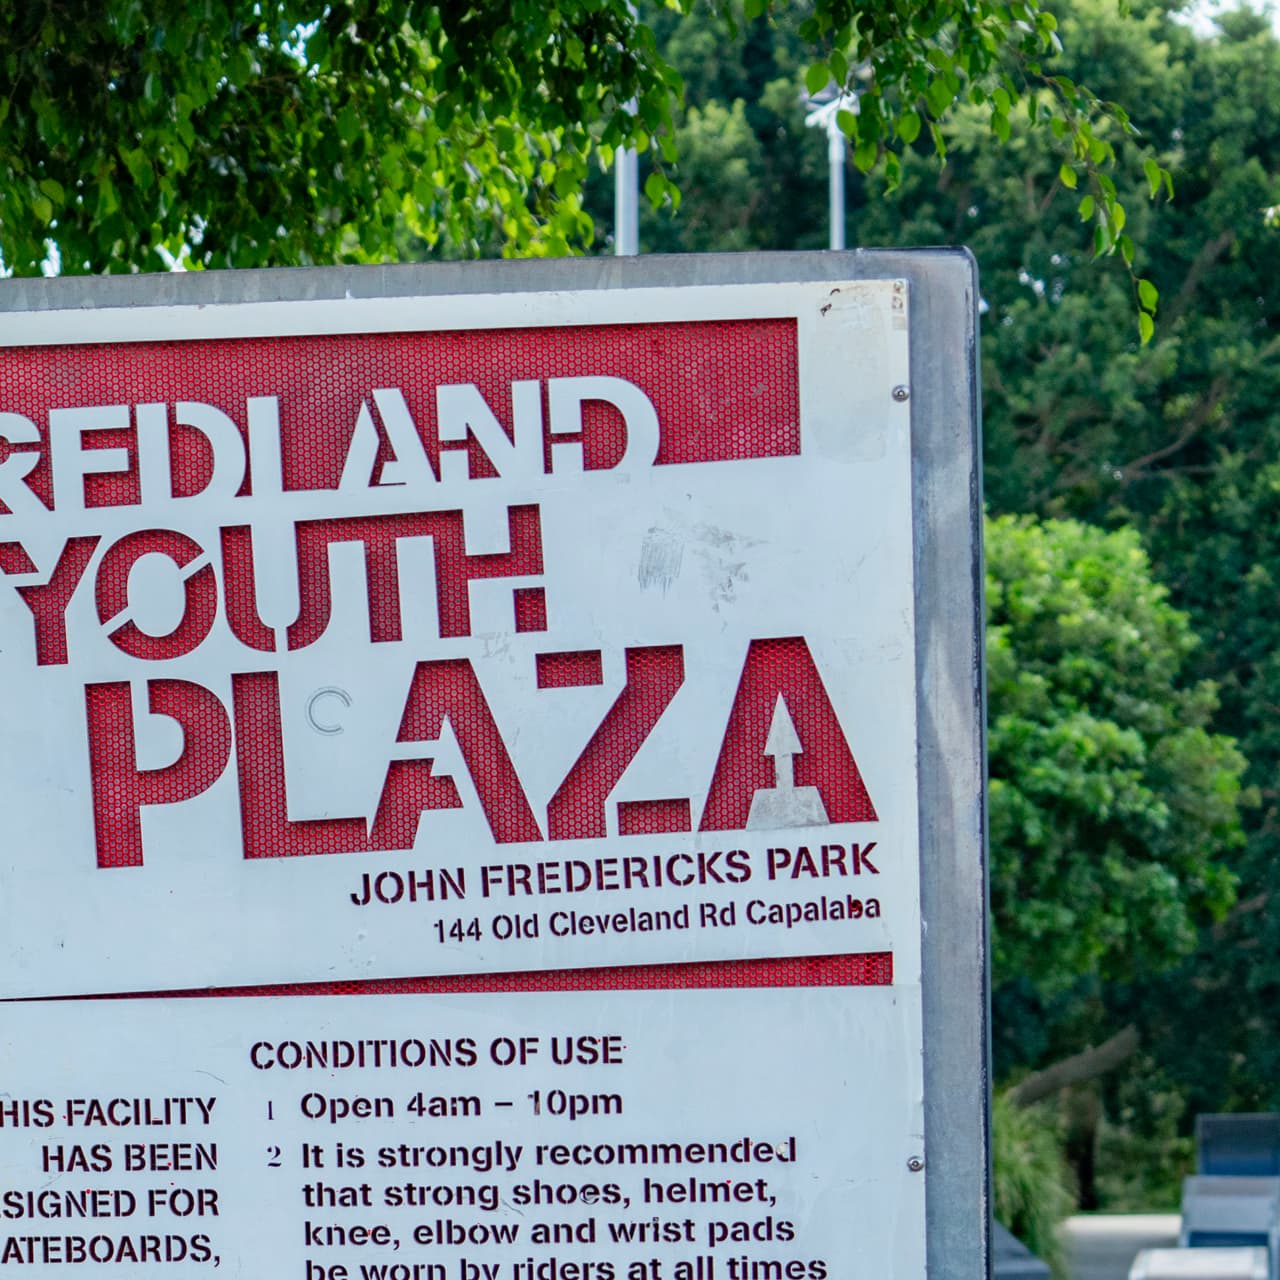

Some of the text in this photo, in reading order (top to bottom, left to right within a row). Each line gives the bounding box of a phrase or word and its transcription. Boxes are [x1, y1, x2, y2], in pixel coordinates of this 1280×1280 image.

[85, 635, 879, 869] PLAZA
[350, 842, 880, 906] JOHN FREDERICKS PARK
[434, 894, 881, 943] 144 Old Cleveland Rd Capalaba
[250, 1036, 622, 1069] CONDITIONS OF USE
[67, 1098, 216, 1126] FACILITY
[301, 1093, 393, 1124] Open
[407, 1092, 481, 1117] 4am
[528, 1090, 622, 1120] 10pm
[42, 1143, 217, 1172] HAS BEEN
[267, 1137, 795, 1172] 2 It is strongly recommended
[148, 1189, 219, 1216] FOR
[305, 1216, 794, 1250] knee, elbow and wrist pads
